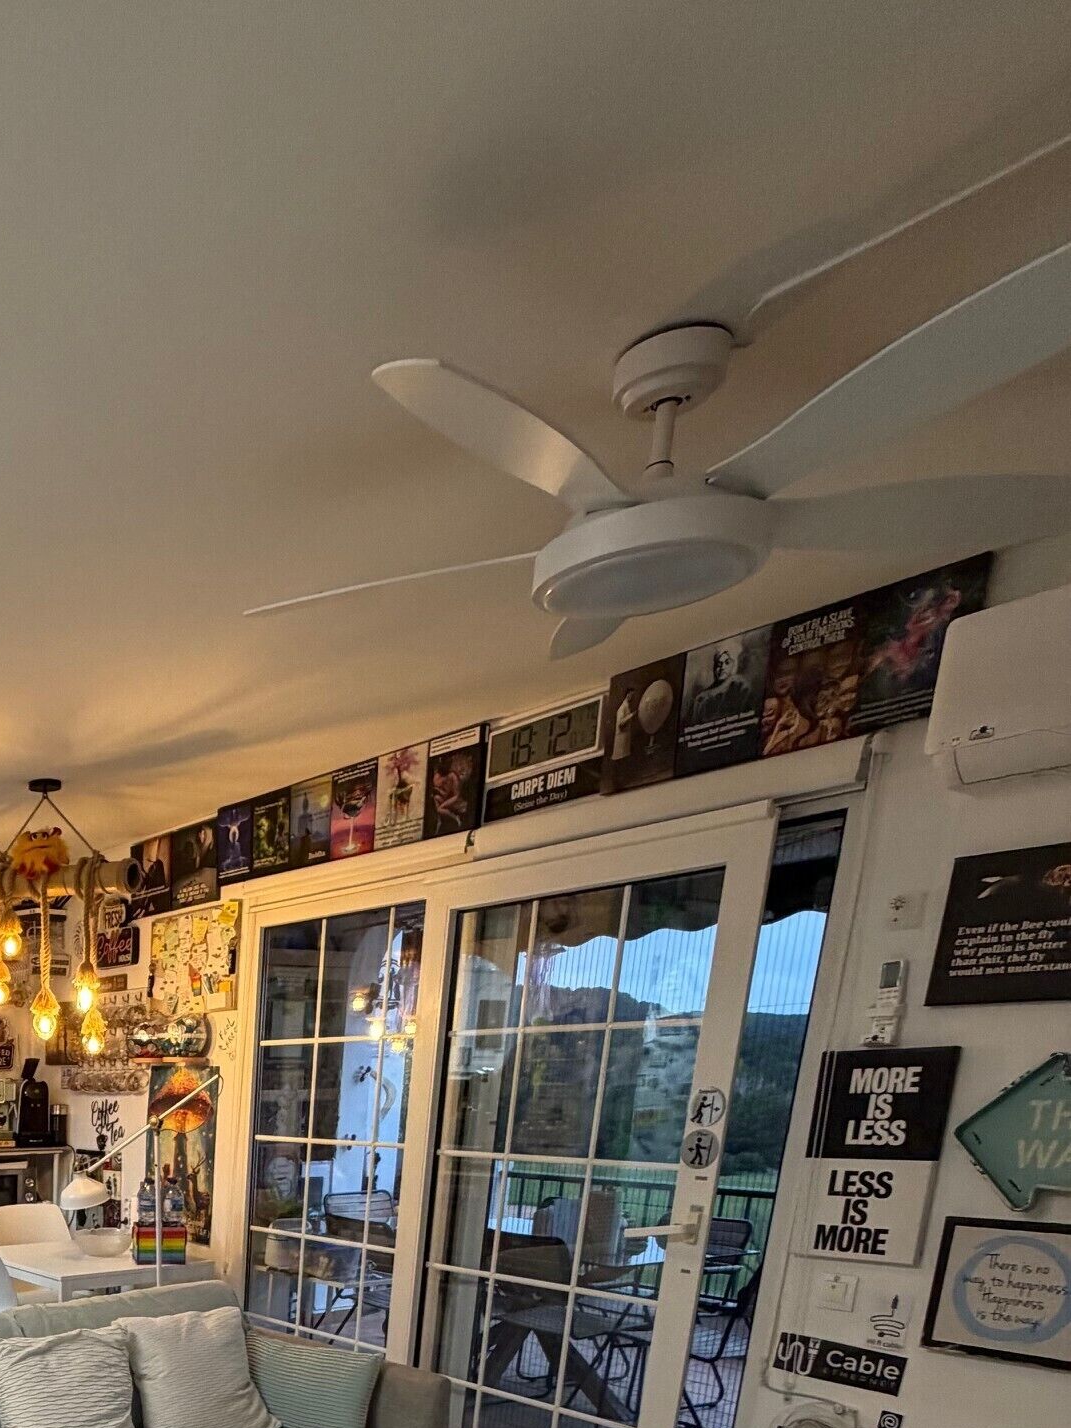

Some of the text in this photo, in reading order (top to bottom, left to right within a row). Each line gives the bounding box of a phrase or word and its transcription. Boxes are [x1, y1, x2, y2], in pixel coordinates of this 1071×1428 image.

[511, 766, 576, 800] CARPE DIEM
[955, 929, 1055, 947] explain to the fly
[958, 926, 986, 936] Even
[987, 923, 999, 933] if
[1000, 922, 1018, 932] the
[1020, 920, 1044, 931] Bee
[951, 951, 1046, 967] than shit, the fly
[954, 947, 977, 957] why
[1015, 942, 1025, 952] is
[1027, 940, 1067, 951] better
[949, 962, 1071, 977] would not understan
[849, 1066, 923, 1094] MORE
[91, 1099, 119, 1128] Coffee
[866, 1093, 893, 1120] IS
[1030, 1100, 1071, 1131] TH
[106, 1117, 125, 1146] Tea
[845, 1119, 907, 1146] LESS
[1017, 1139, 1071, 1169] WA
[827, 1169, 894, 1198] LESS
[841, 1198, 868, 1226] IS
[813, 1223, 889, 1256] MORE
[985, 1253, 1050, 1275] There is no
[991, 1276, 1005, 1287] to
[982, 1287, 1044, 1312] Happiness
[990, 1310, 1012, 1322] the
[826, 1350, 900, 1380] Cable
